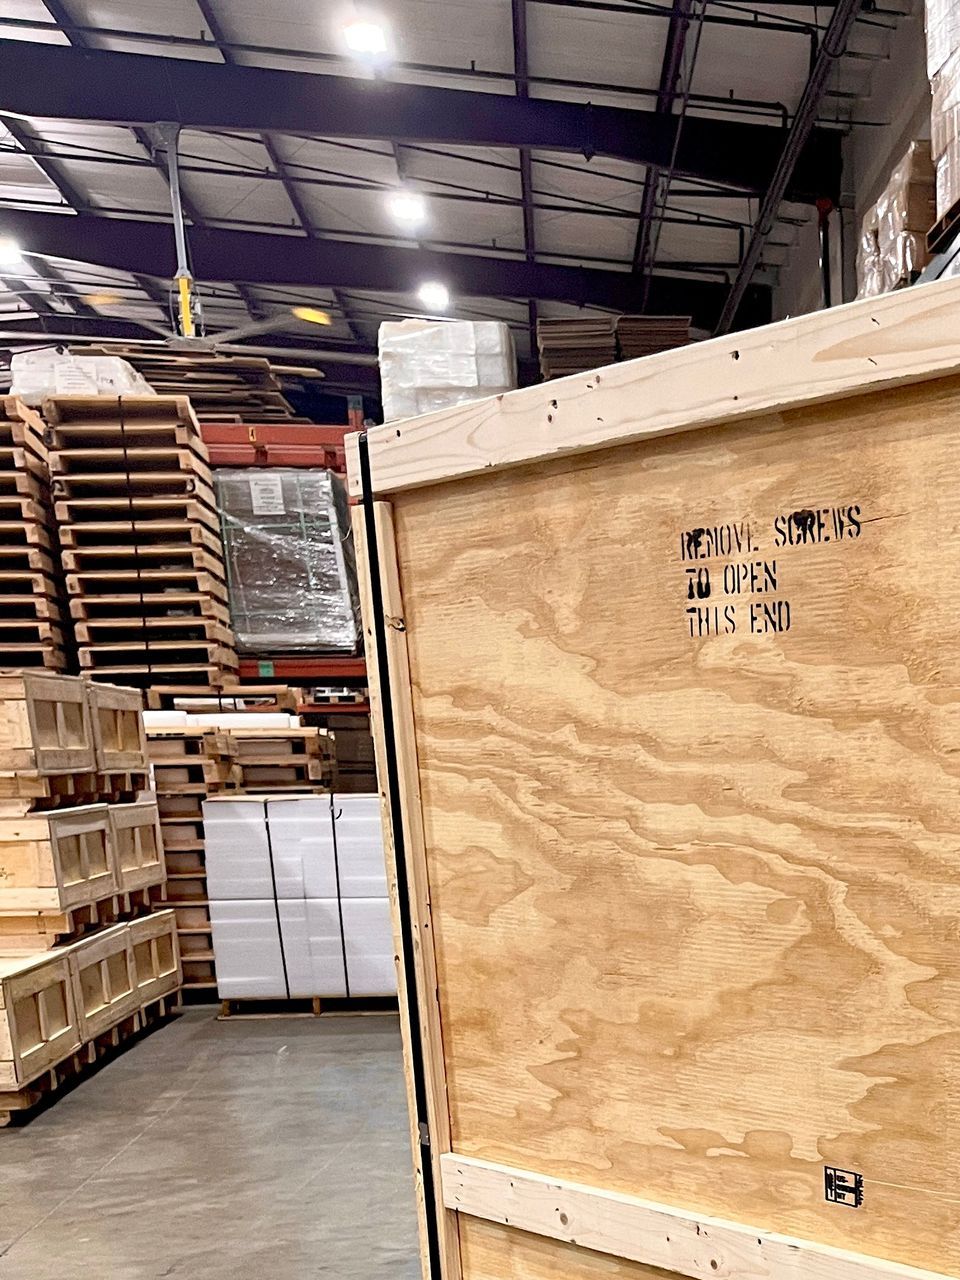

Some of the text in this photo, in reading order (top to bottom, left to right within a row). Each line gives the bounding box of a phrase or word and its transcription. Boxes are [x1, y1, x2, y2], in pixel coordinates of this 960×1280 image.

[680, 505, 861, 561] REMOVE SCREWS
[685, 560, 777, 599] TO OPEN
[686, 600, 791, 637] THIS END
